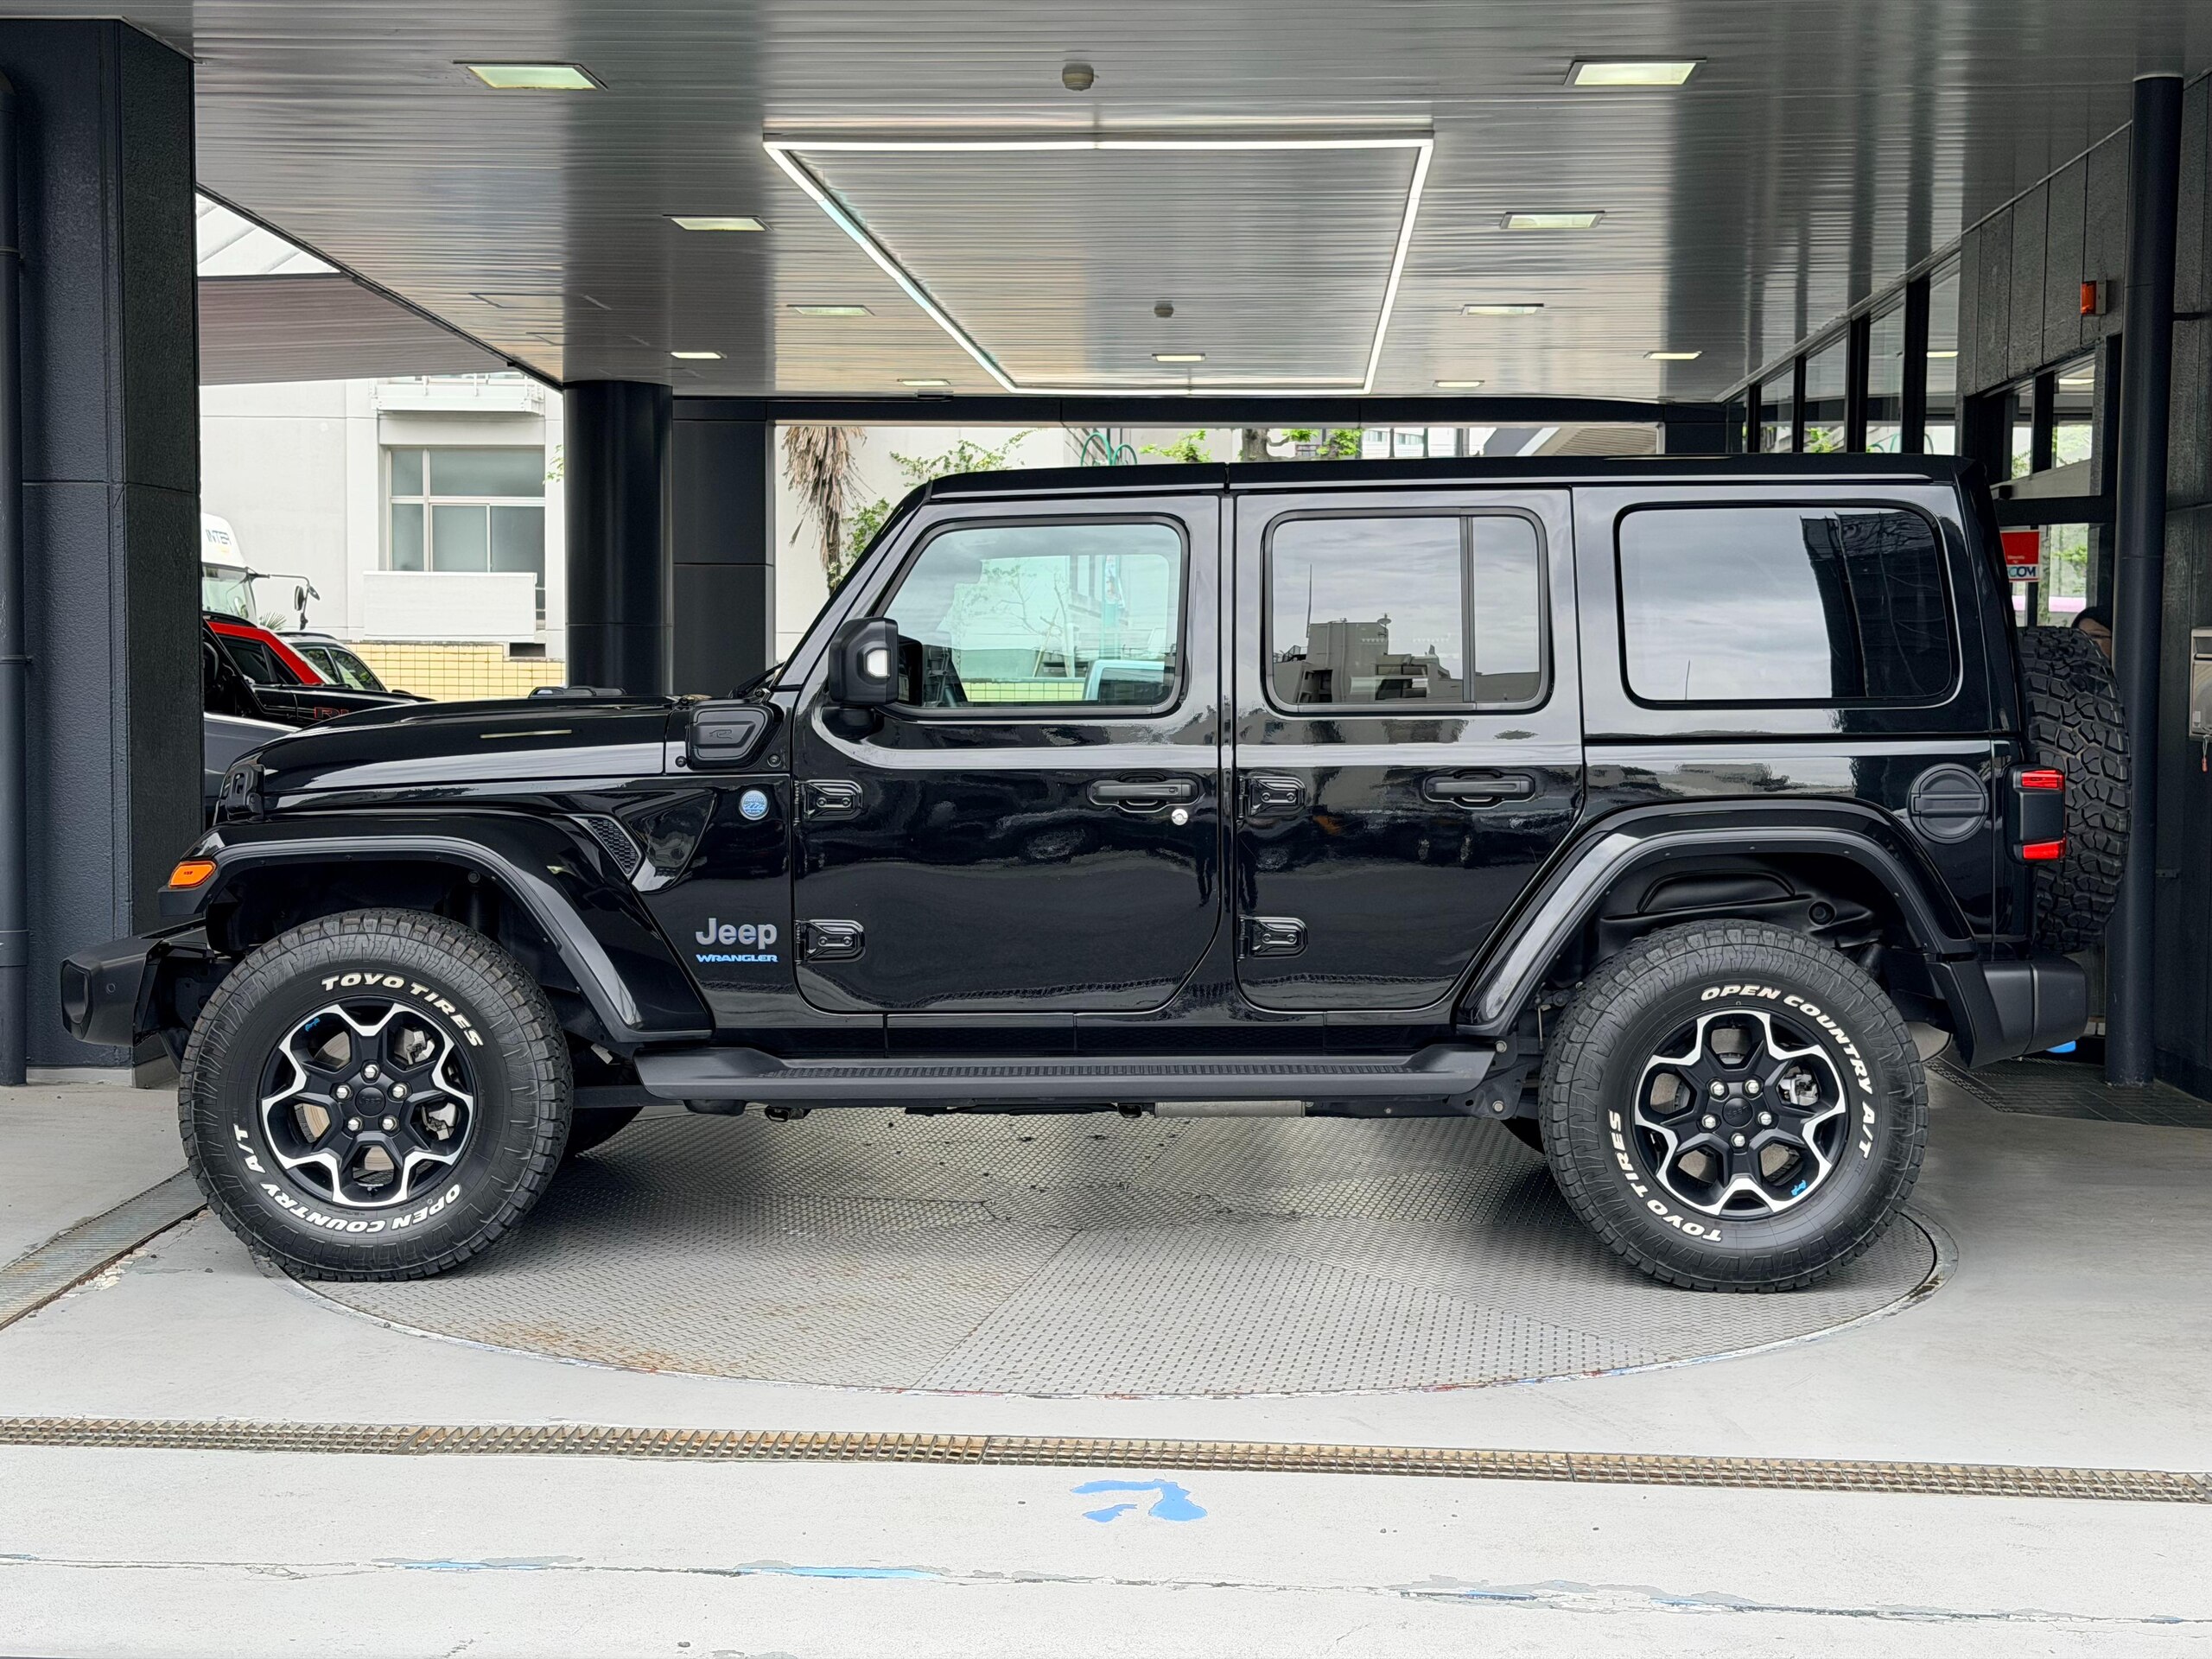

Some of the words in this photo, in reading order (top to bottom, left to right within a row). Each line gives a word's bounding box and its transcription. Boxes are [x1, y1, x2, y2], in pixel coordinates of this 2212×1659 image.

[696, 918, 778, 950] Jeep
[696, 954, 779, 963] WRANGLER
[321, 972, 405, 992] TOYO
[410, 982, 484, 1047] TIRES
[1700, 984, 1782, 1002] OPEN
[1783, 994, 1873, 1095] COUNTRY
[1857, 1101, 1876, 1160] A/T
[233, 1123, 266, 1173] A/T
[1608, 1109, 1649, 1198] TIRES
[260, 1182, 386, 1234] COUNTRY
[391, 1183, 461, 1231] OPEN
[1646, 1198, 1723, 1243] TOYO
